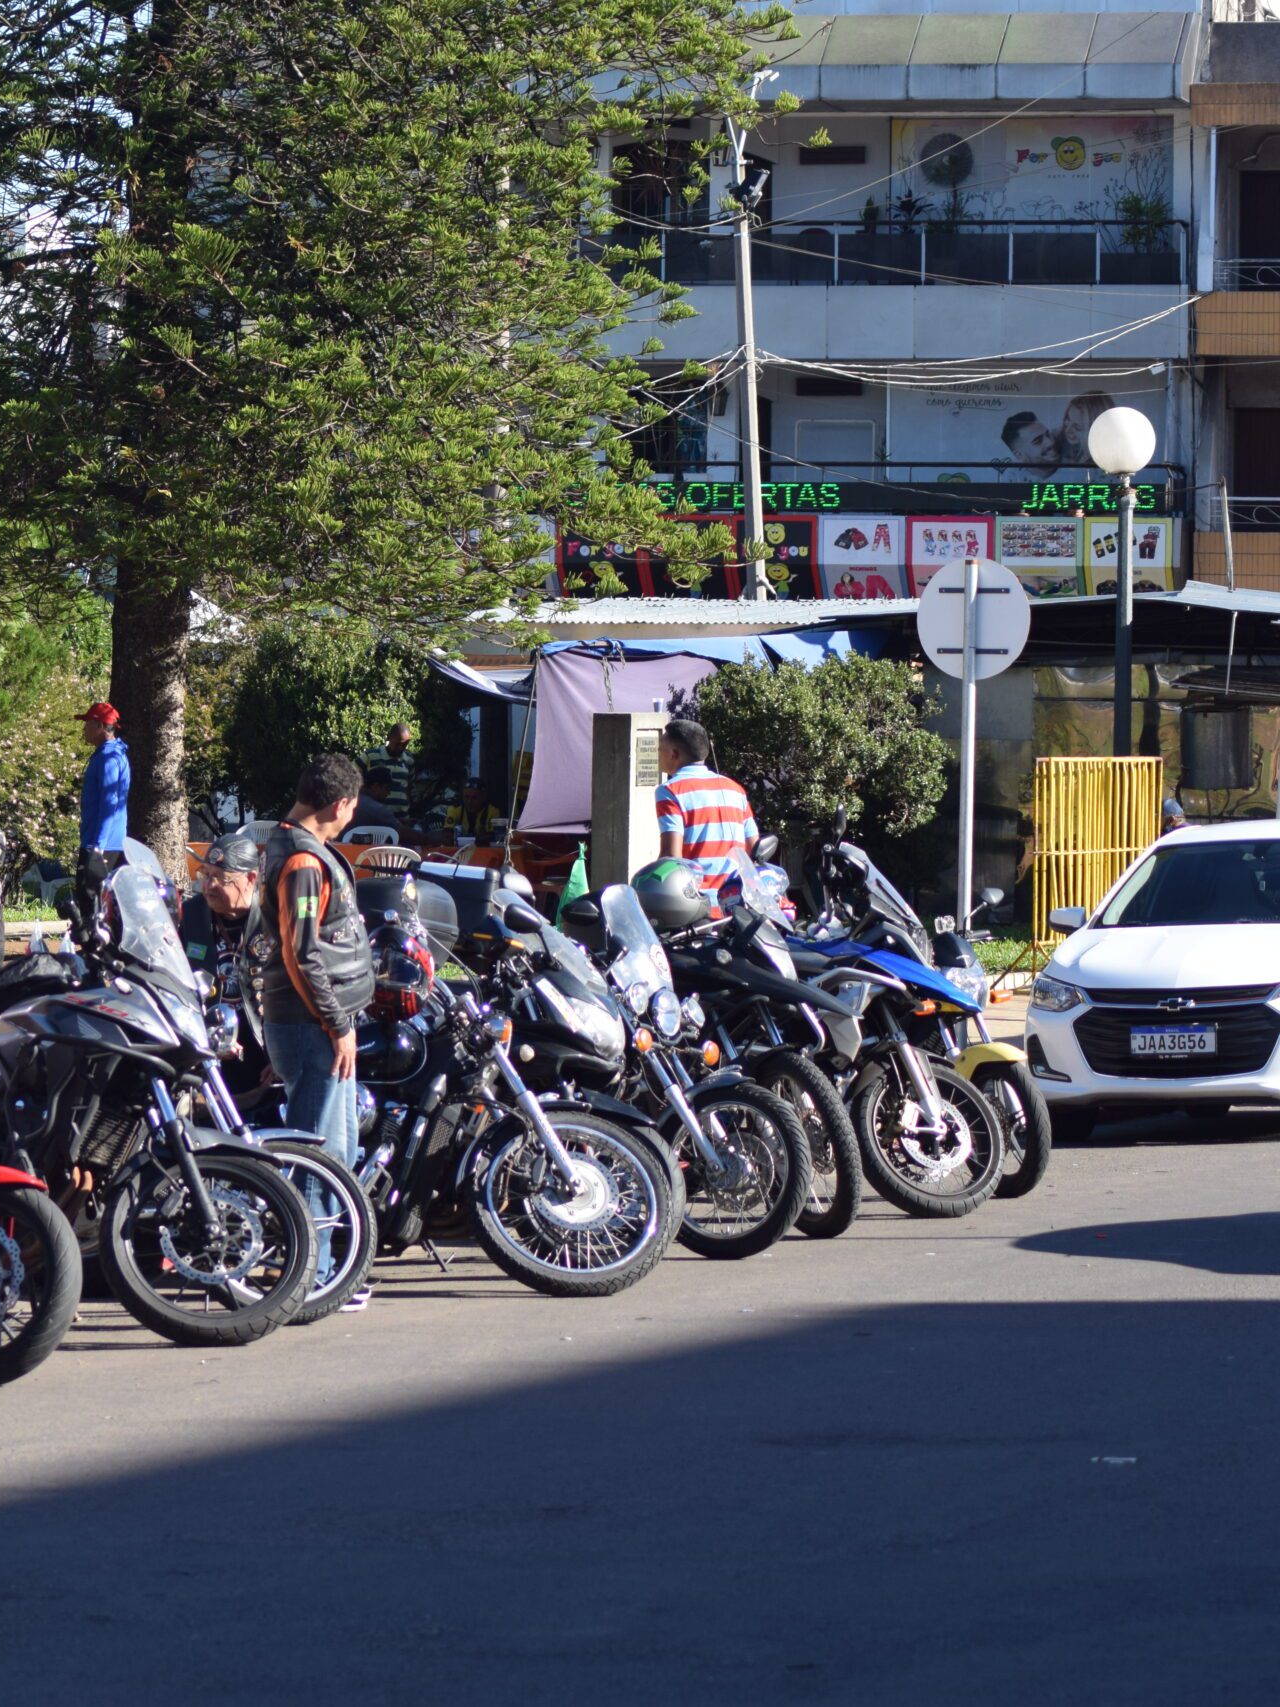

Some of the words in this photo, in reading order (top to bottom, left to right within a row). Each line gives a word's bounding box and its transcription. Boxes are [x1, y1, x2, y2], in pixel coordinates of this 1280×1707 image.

[686, 483, 840, 508] OFERTAS
[1022, 484, 1155, 510] JARRS
[1138, 1034, 1207, 1051] JAA3G56
